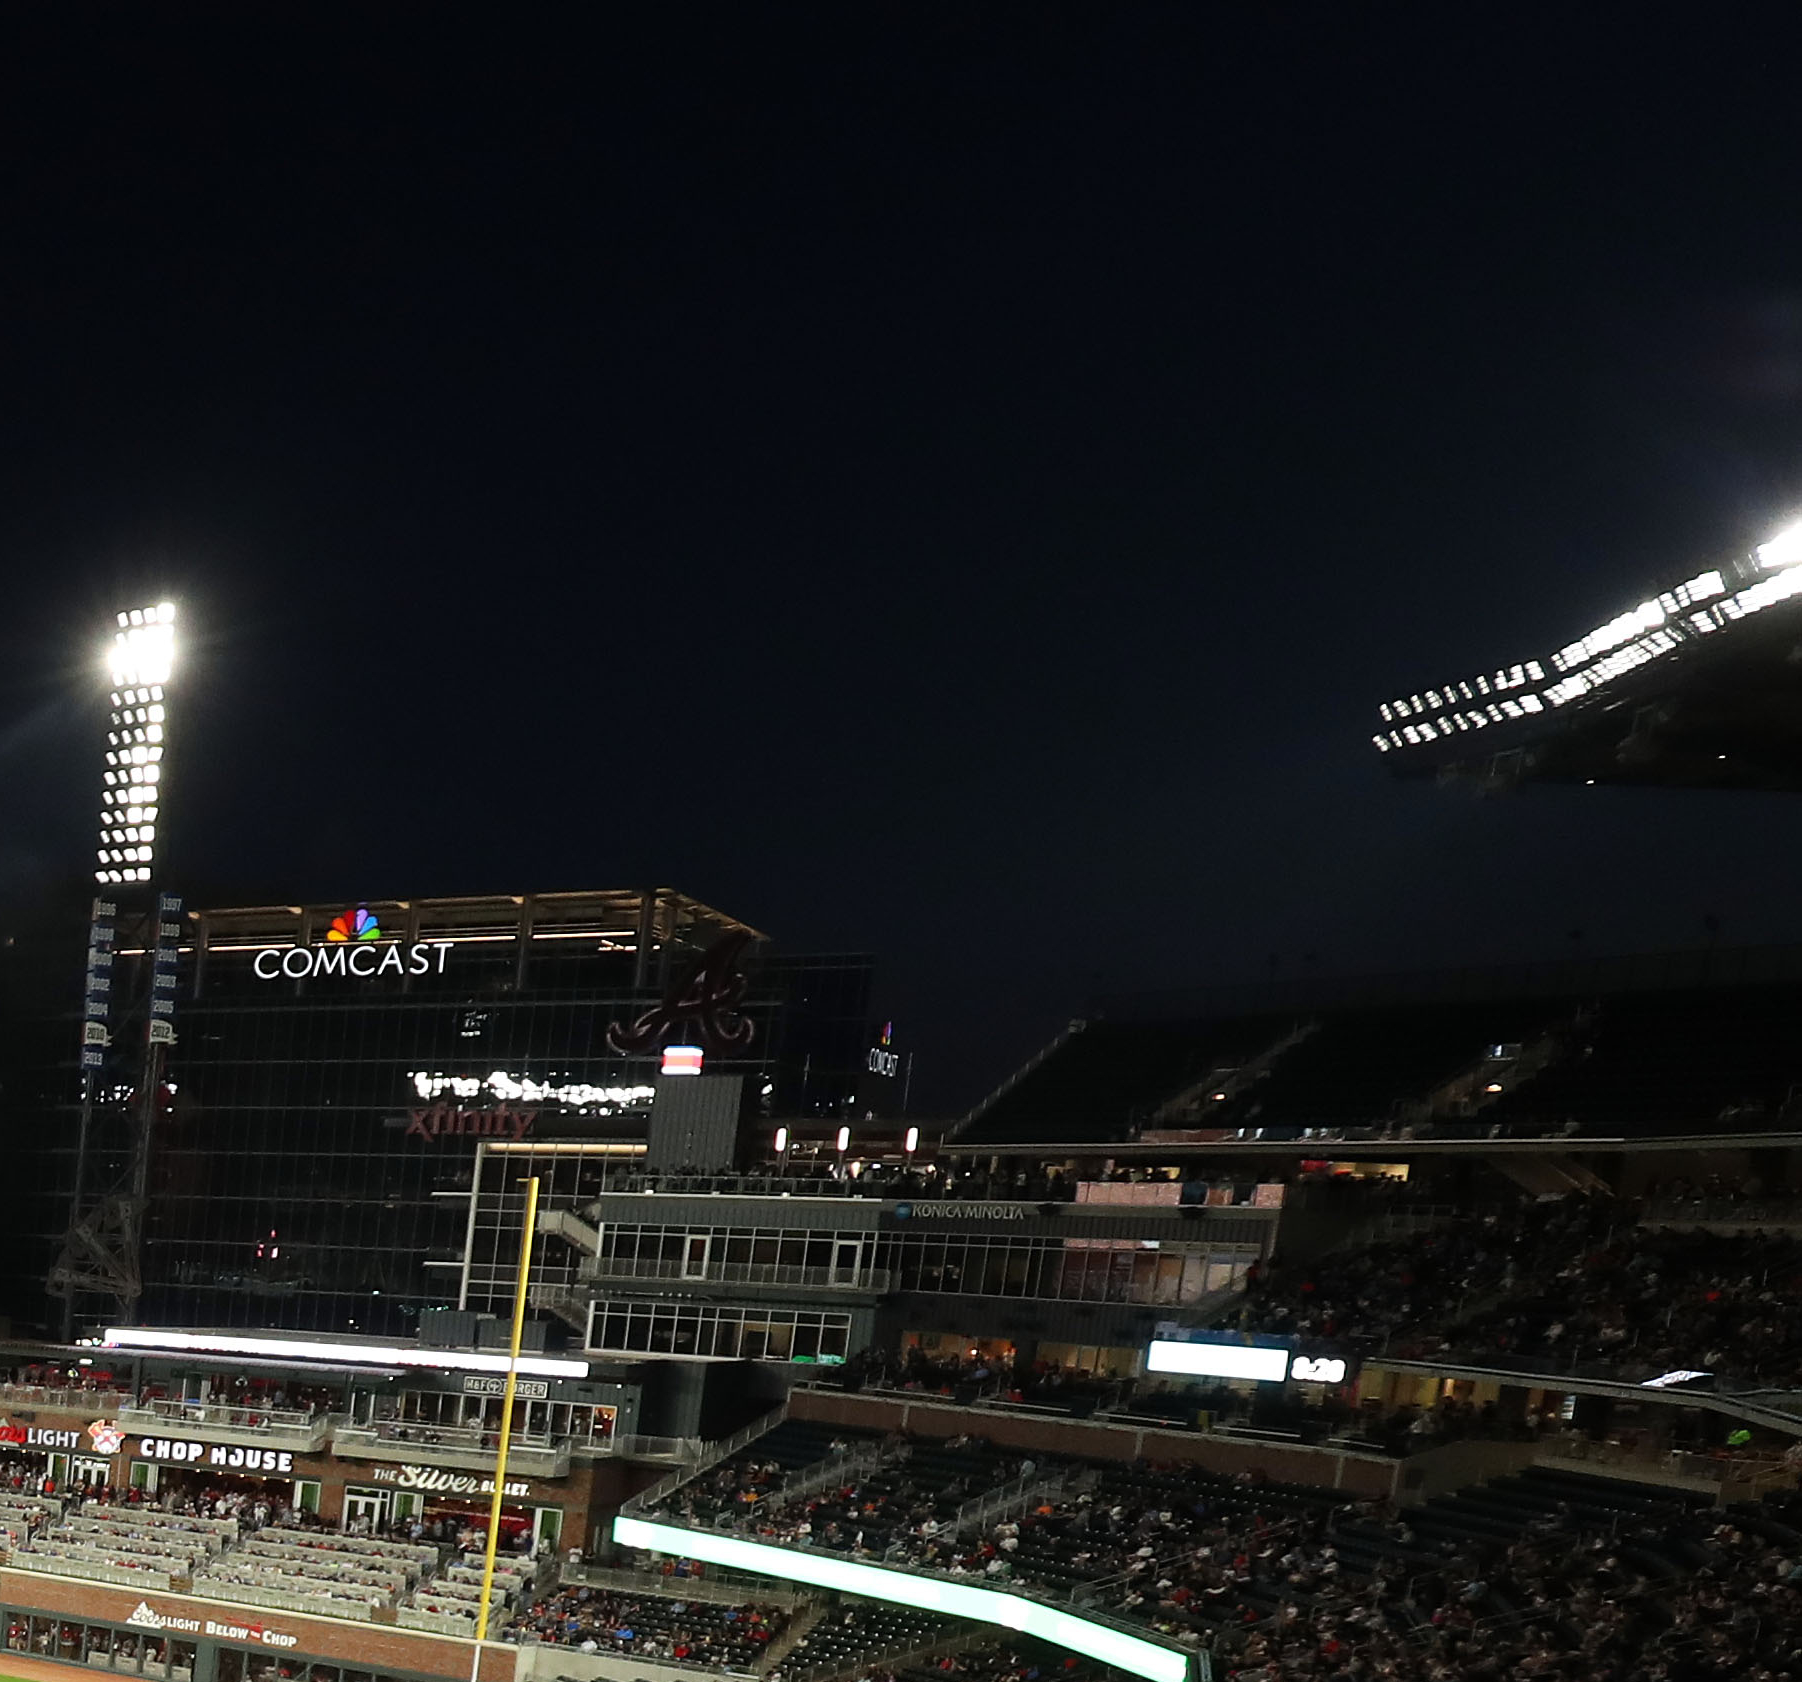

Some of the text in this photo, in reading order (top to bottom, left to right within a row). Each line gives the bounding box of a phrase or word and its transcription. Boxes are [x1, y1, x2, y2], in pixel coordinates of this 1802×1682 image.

[254, 943, 454, 979] COMCAST
[407, 1102, 538, 1141] xfinity
[912, 1204, 1024, 1219] KONICA MINOLTA
[27, 1427, 80, 1449] LIGHT
[140, 1438, 293, 1473] CHOP HOUSE
[374, 1468, 396, 1480] THE
[397, 1464, 480, 1494] Silver
[167, 1618, 201, 1632] LIGHT
[206, 1620, 249, 1640] BELOW
[262, 1630, 297, 1648] CHOP
